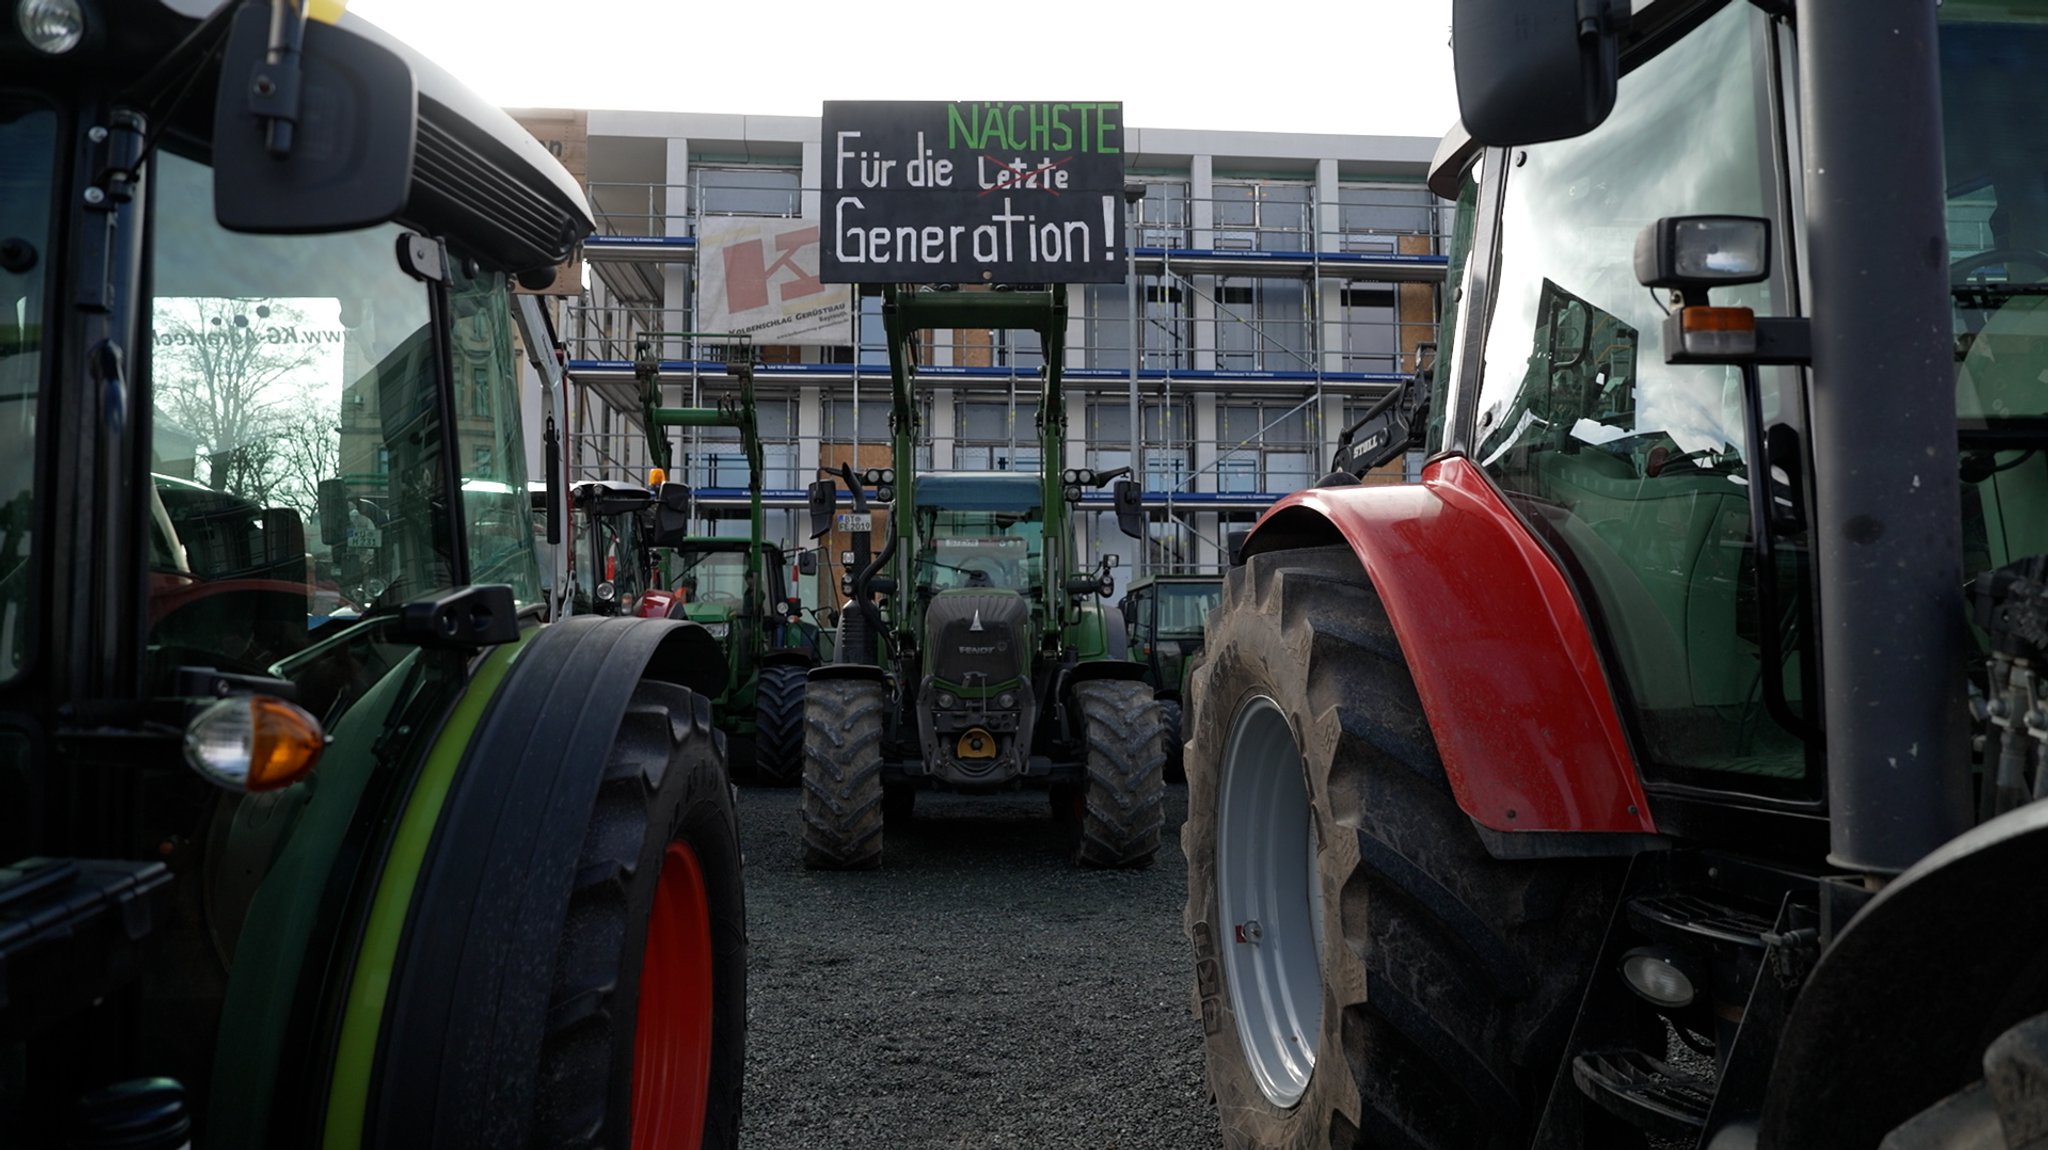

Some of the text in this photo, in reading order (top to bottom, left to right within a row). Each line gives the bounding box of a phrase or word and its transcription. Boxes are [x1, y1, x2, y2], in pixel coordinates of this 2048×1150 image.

[947, 102, 1120, 153] NÄCHSTE
[836, 131, 1069, 189] Für die Letzte
